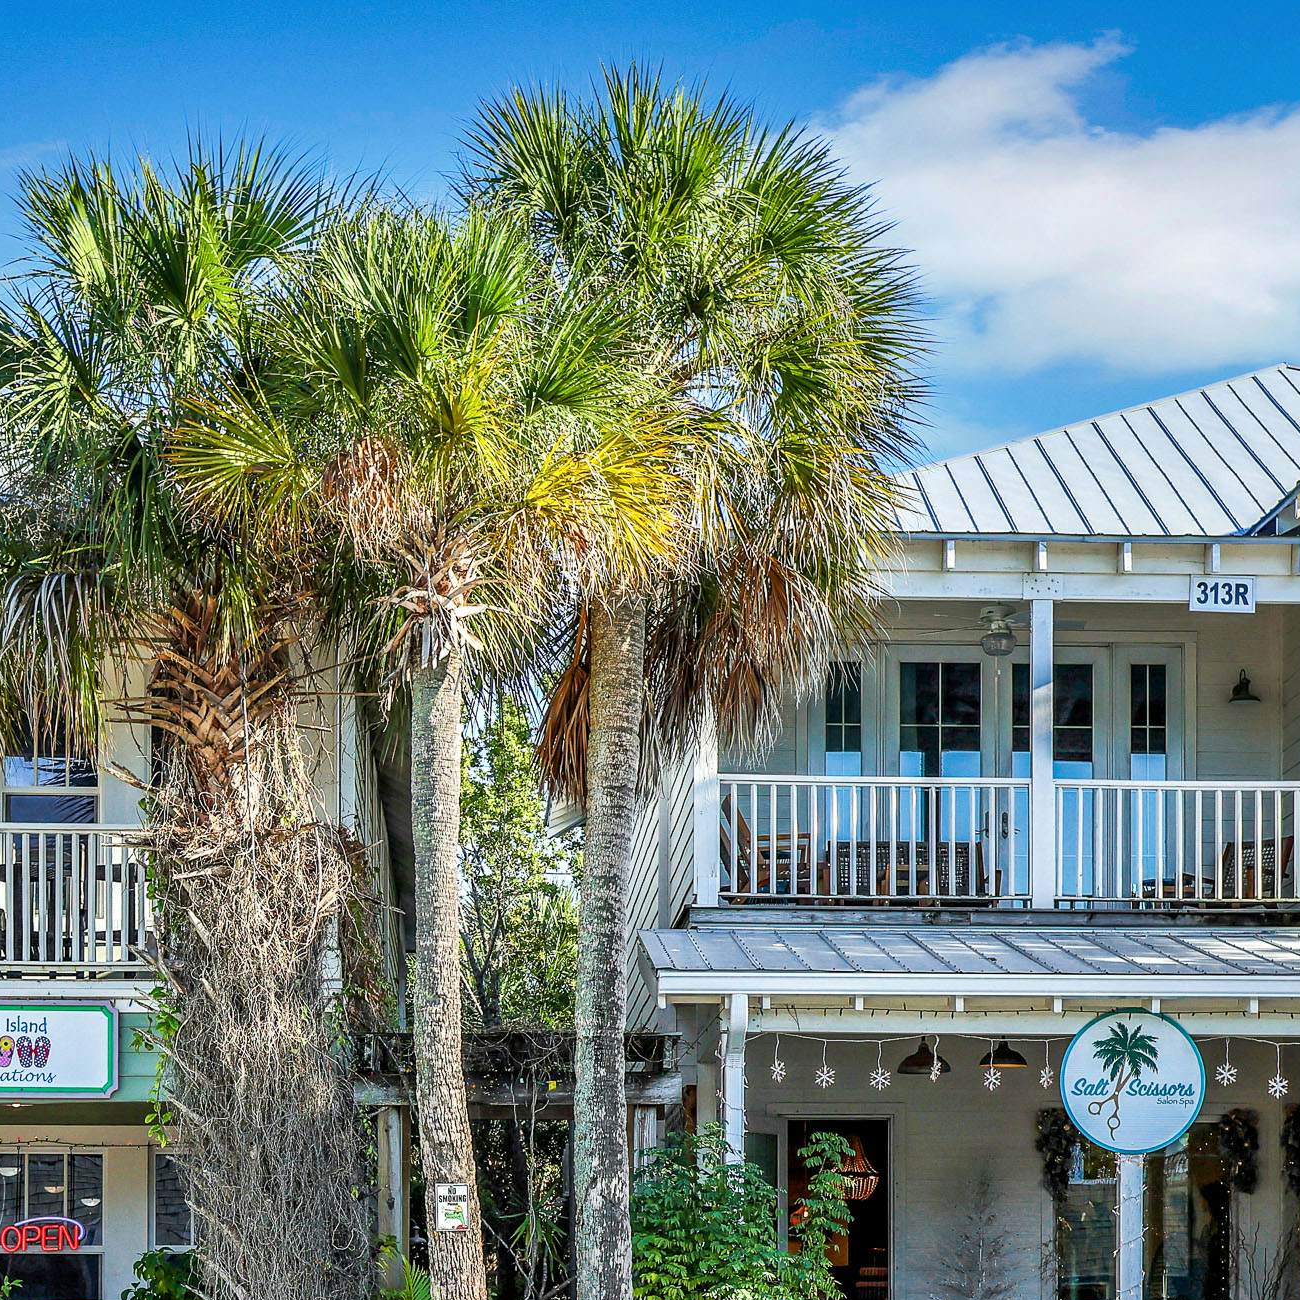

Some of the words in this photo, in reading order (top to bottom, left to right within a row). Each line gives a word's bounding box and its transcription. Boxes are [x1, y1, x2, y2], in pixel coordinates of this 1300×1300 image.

[1196, 582, 1249, 606] 313R
[6, 1015, 48, 1034] Island
[1071, 1078, 1110, 1097] Salt
[1126, 1079, 1195, 1097] Scissors
[1156, 1096, 1178, 1105] Salon
[1179, 1097, 1194, 1109] Spa
[438, 1195, 467, 1203] SMOKING
[447, 1187, 457, 1195] NO
[0, 1225, 79, 1252] OPEN
